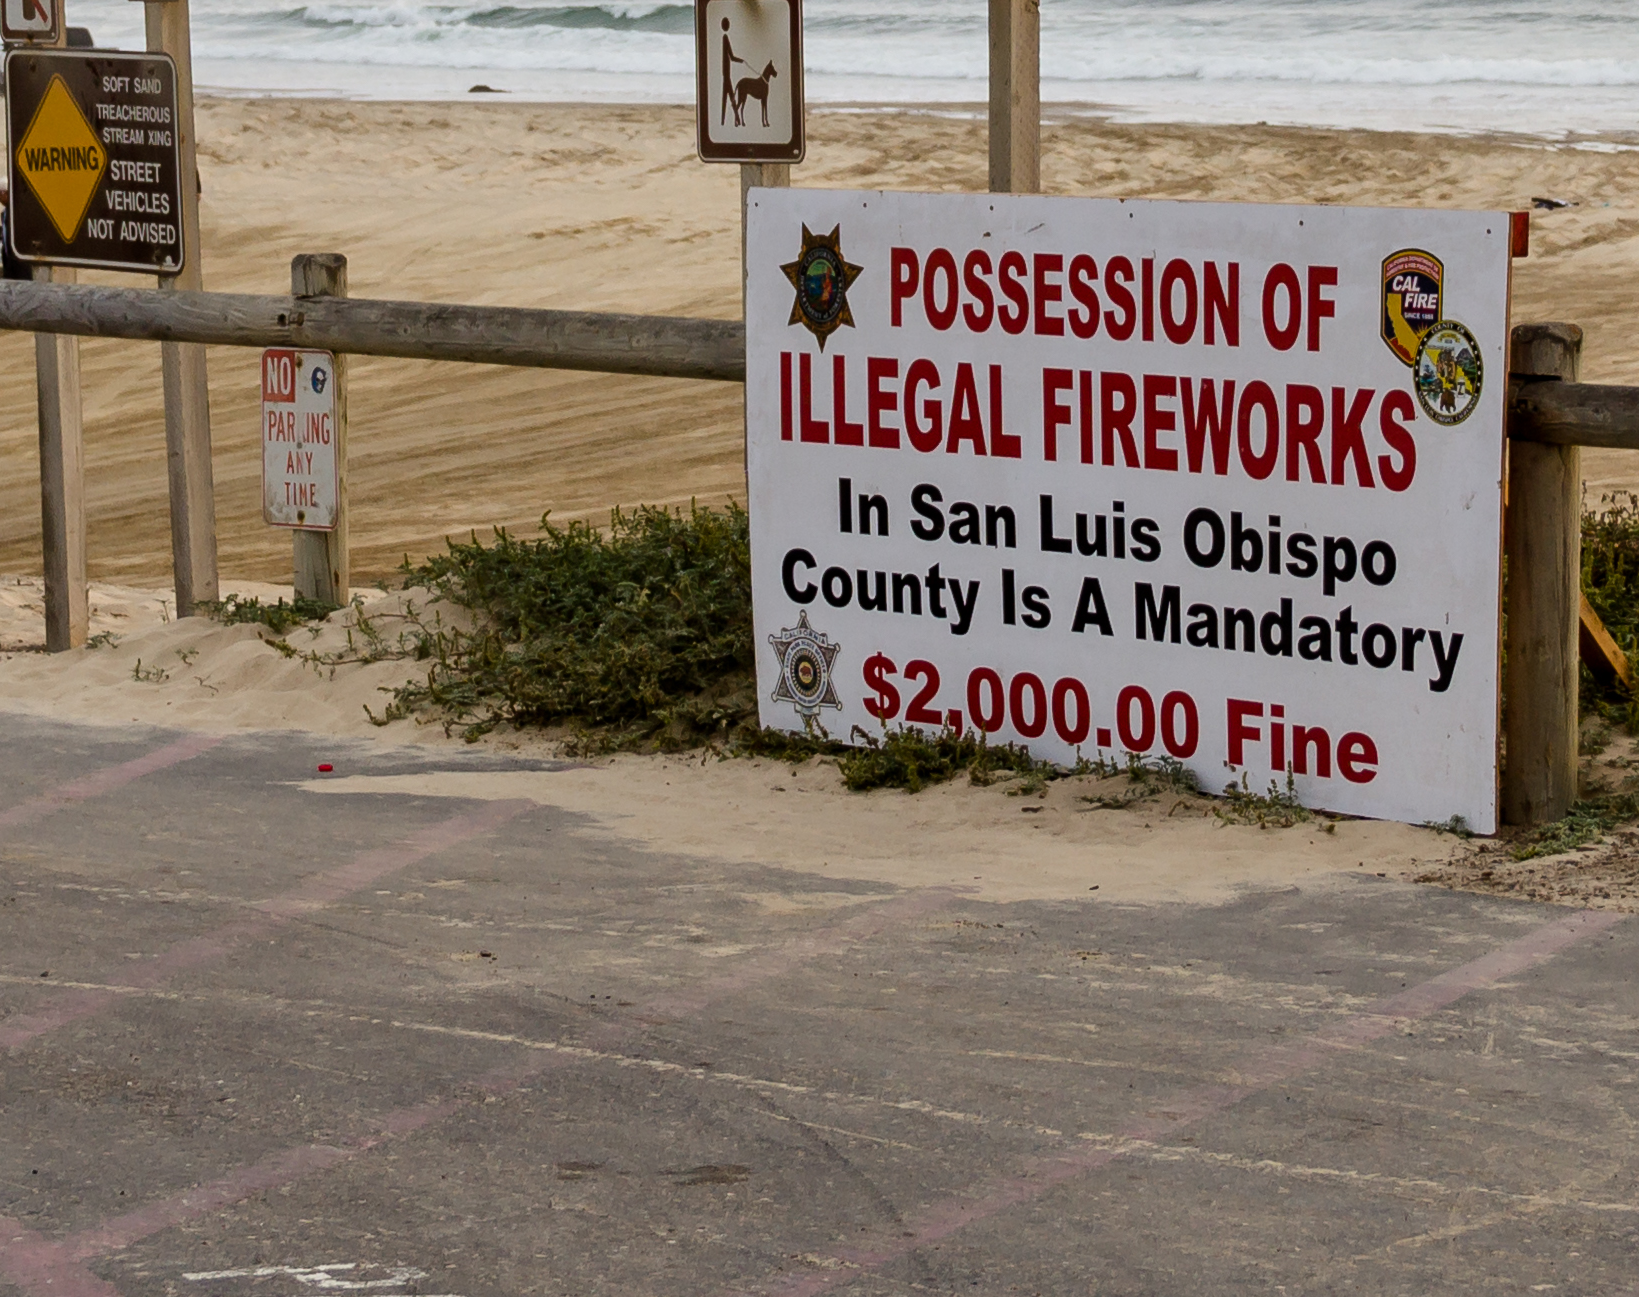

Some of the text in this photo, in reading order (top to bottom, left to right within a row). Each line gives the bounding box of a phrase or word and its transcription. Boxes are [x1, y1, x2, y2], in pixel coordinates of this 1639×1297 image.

[103, 76, 161, 93] SOFT SAND
[96, 104, 170, 123] TREACHEROUS
[103, 127, 171, 146] STREAM XING
[25, 146, 99, 171] WARNING
[111, 160, 161, 183] STREET
[105, 190, 169, 214] VEHICLES
[88, 218, 175, 244] NOT ADVISED
[1393, 276, 1420, 291] CAL
[891, 247, 1338, 352] POSSESSION OF
[1404, 293, 1438, 309] FIRE
[267, 357, 291, 395] NO
[268, 410, 330, 444] PARING
[780, 351, 1417, 492] ILLEGAL FIREWORKS
[287, 451, 312, 475] ANY
[285, 482, 316, 507] TIME
[838, 477, 1397, 596] In San Luis Obispo
[781, 548, 1464, 693] County Is A Mandatory
[784, 629, 826, 644] CALIFORNIA
[861, 652, 1379, 783] $2,000.00 Fine
